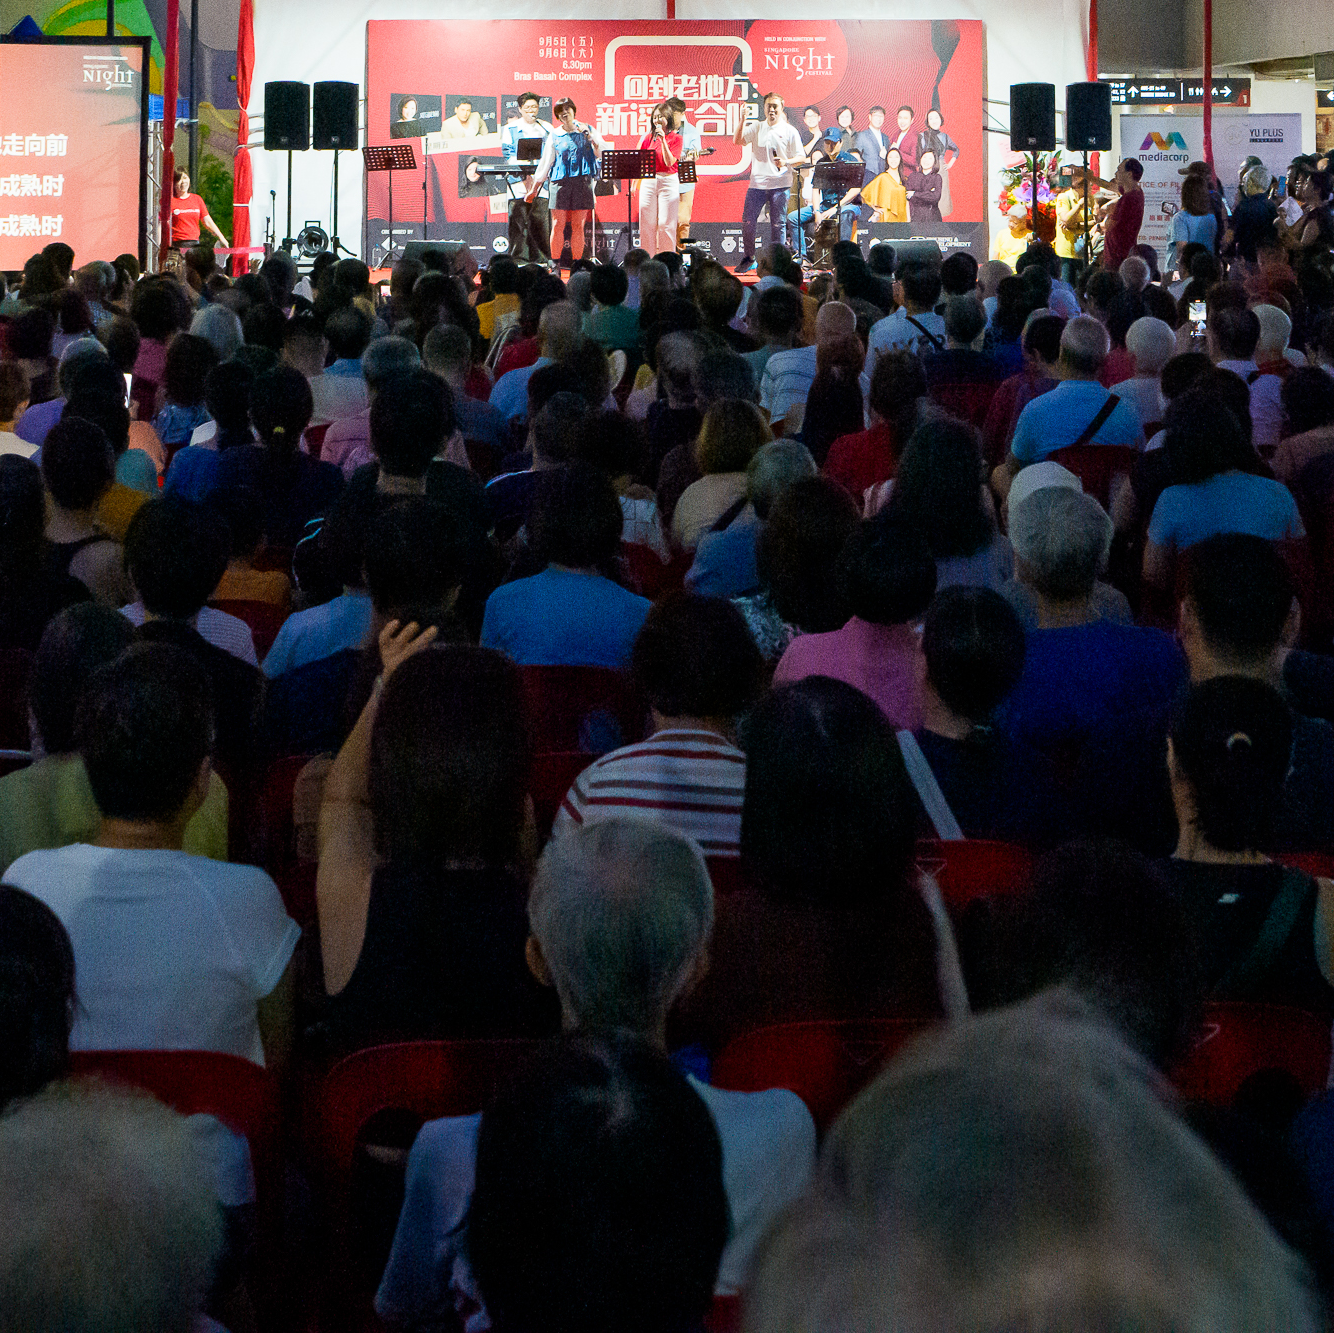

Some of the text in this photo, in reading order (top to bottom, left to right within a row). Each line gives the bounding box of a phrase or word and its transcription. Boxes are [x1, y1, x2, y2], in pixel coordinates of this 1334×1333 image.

[562, 60, 592, 71] 6.30pm
[514, 71, 593, 83] Bras Basah Complex
[1249, 128, 1284, 138] YU PLUS
[1138, 151, 1189, 164] mediacorp
